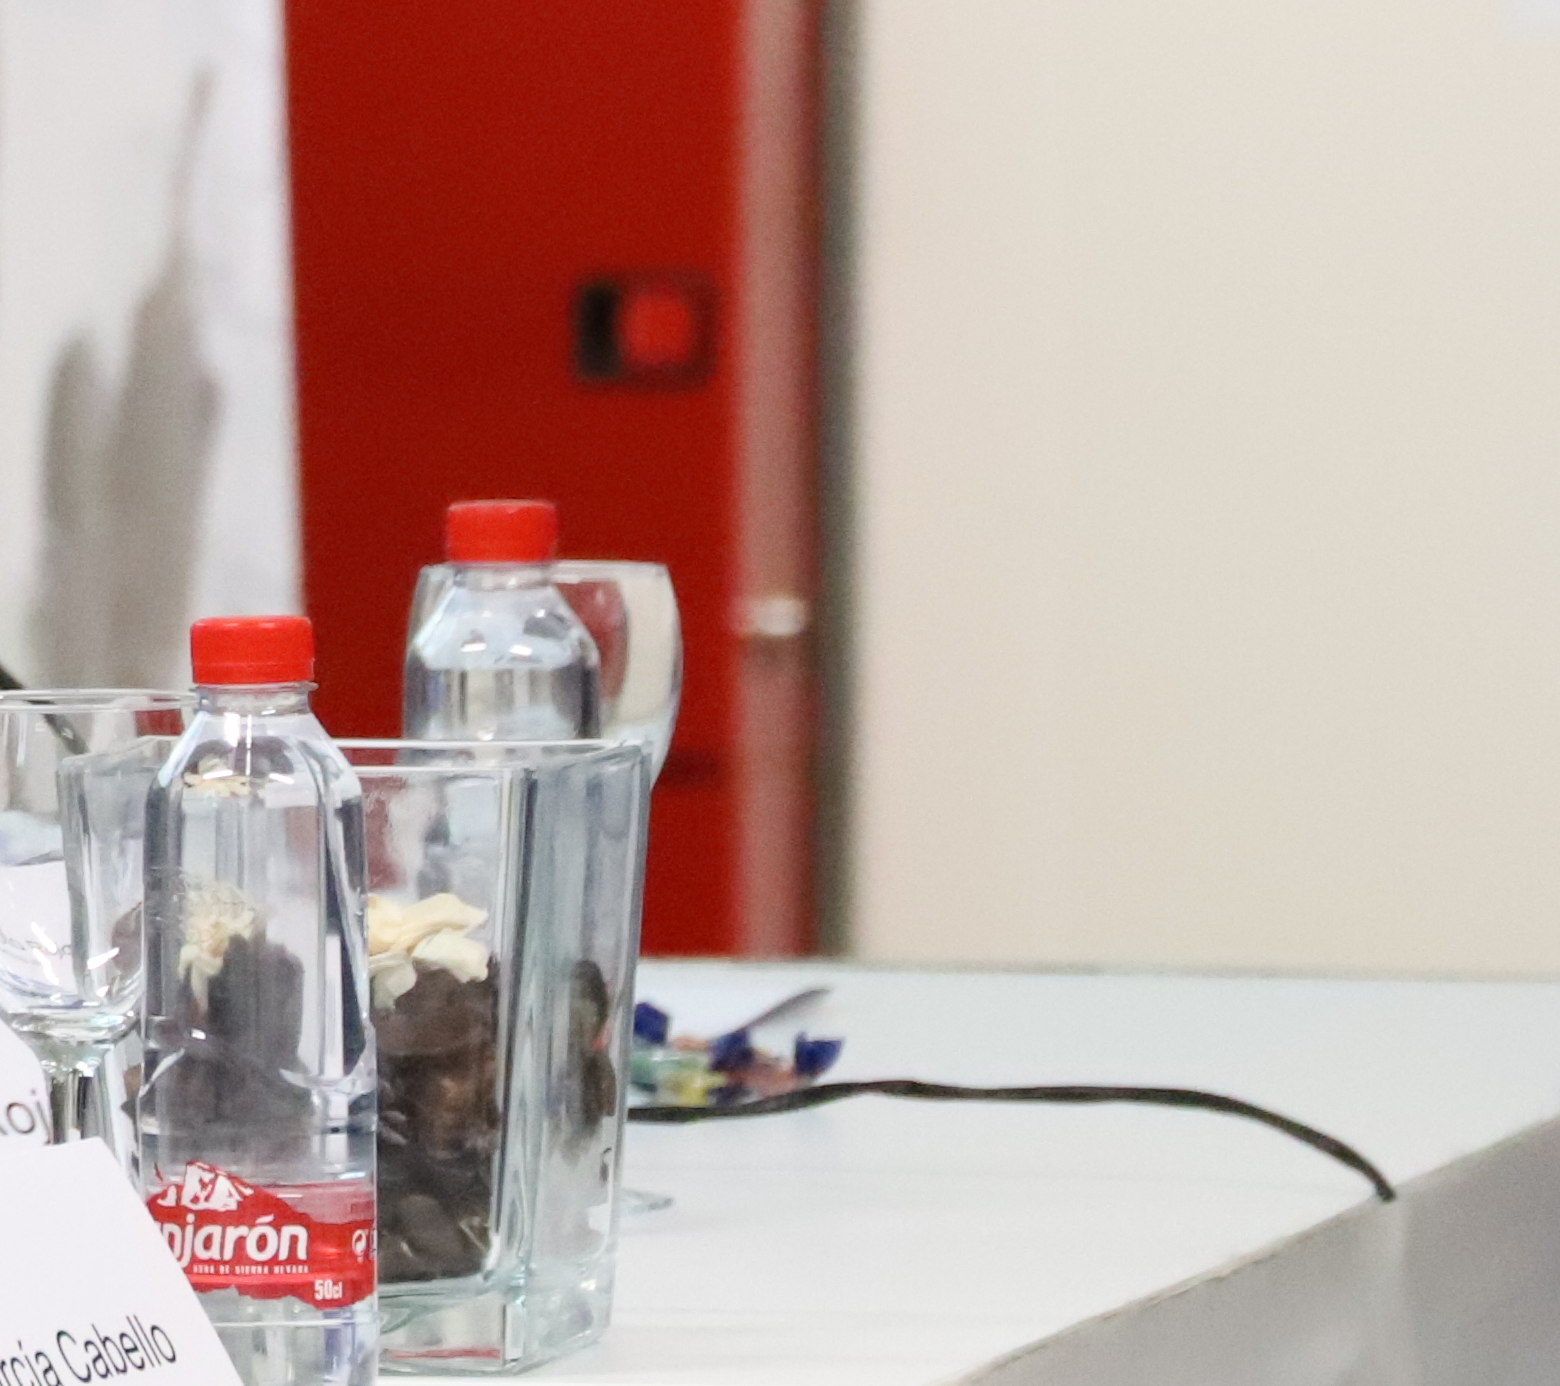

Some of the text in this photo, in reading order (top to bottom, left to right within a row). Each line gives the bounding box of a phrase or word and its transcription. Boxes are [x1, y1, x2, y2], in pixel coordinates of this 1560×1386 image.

[155, 1213, 309, 1269] njarón
[314, 1279, 343, 1301] 50cl
[55, 1314, 178, 1384] Cabello
